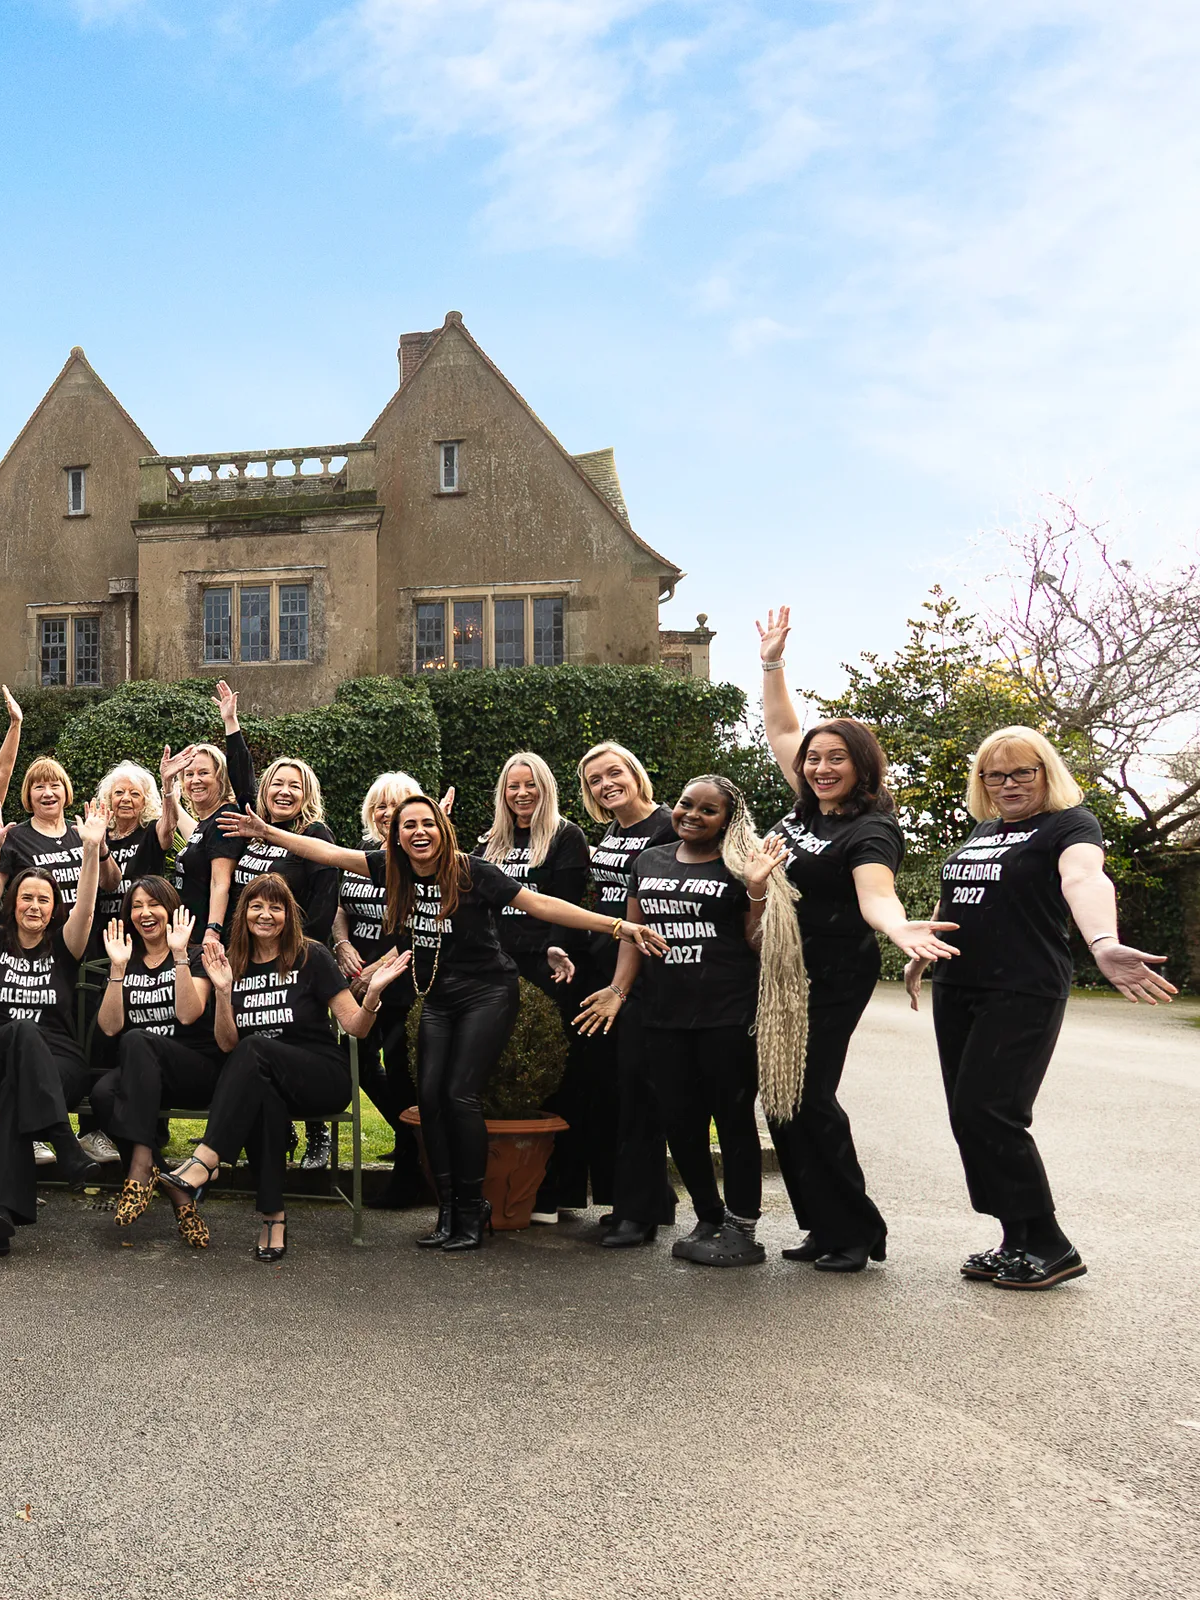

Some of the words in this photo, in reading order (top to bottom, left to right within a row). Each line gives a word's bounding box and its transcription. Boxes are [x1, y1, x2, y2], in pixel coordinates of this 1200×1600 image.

[620, 836, 651, 850] FIRST
[32, 850, 71, 866] LADIES
[591, 851, 630, 868] CHARITY
[52, 866, 82, 883] CHAR
[942, 863, 1002, 881] CALENDAR
[601, 887, 628, 902] 2027
[638, 877, 680, 892] ADIES
[680, 878, 728, 898] FIRST
[952, 886, 985, 904] 2027
[99, 899, 122, 914] 2027
[640, 898, 702, 916] CHARITY
[353, 921, 382, 940] 2027
[404, 914, 453, 933] ALENDAR
[646, 921, 717, 939] ALENDAR
[414, 934, 442, 949] 2027
[0, 952, 30, 972] LADIES
[662, 944, 703, 964] 2027
[4, 969, 51, 987] CHARITY
[123, 973, 156, 988] LADIES
[157, 967, 176, 985] FIRS
[233, 974, 267, 992] LADIES
[269, 970, 299, 987] FIST
[129, 985, 173, 1004] CHARITY
[243, 989, 288, 1008] CHARITY
[8, 1007, 42, 1023] 2027
[128, 1006, 176, 1023] CALENDA
[236, 1007, 294, 1028] CALENDAR
